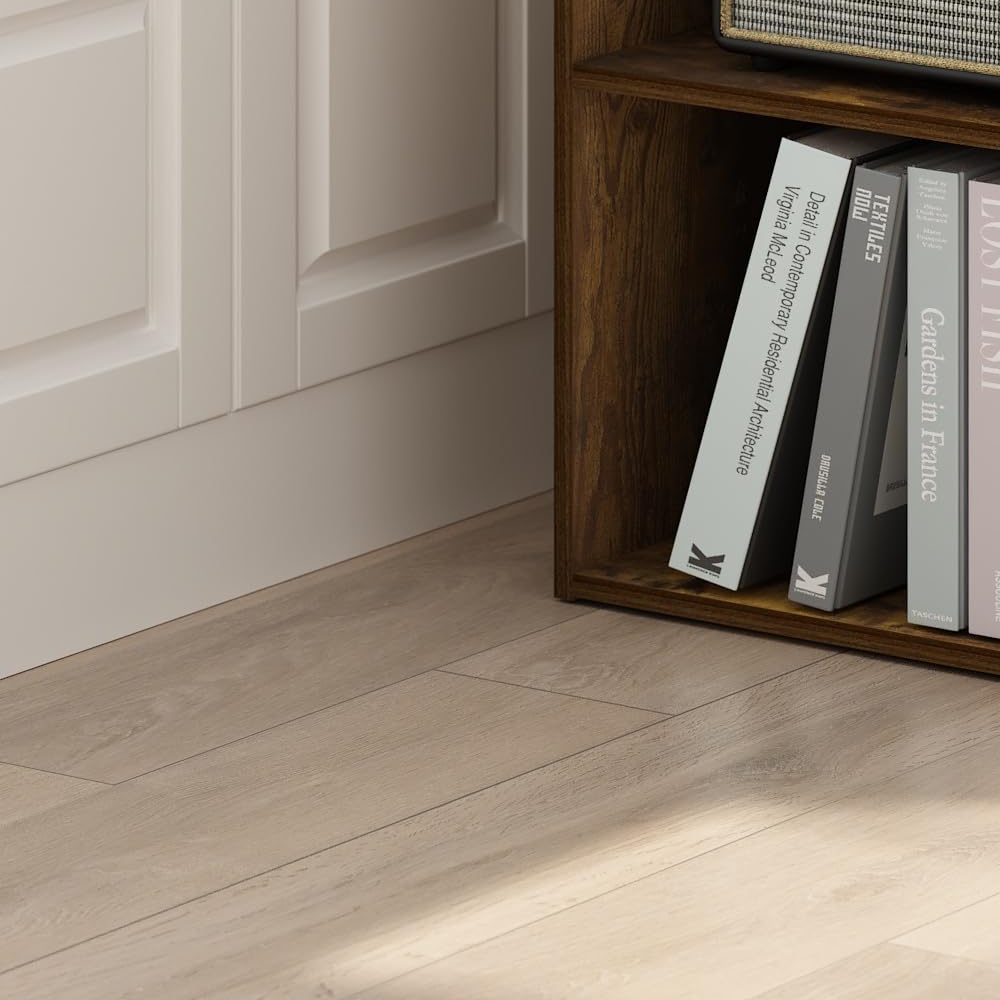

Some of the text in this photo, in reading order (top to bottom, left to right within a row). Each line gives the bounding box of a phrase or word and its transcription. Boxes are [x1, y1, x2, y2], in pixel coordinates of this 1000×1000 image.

[761, 186, 801, 284] Virginia McLeod
[865, 194, 891, 263] TEXTILES
[736, 191, 826, 476] Detail in Contemporary Residential Architecture
[921, 307, 945, 502] Gardens in France
[811, 453, 832, 522] DRUSILLA COLE
[688, 543, 726, 575] K
[794, 565, 830, 596] K
[911, 609, 953, 623] TASCHEN
